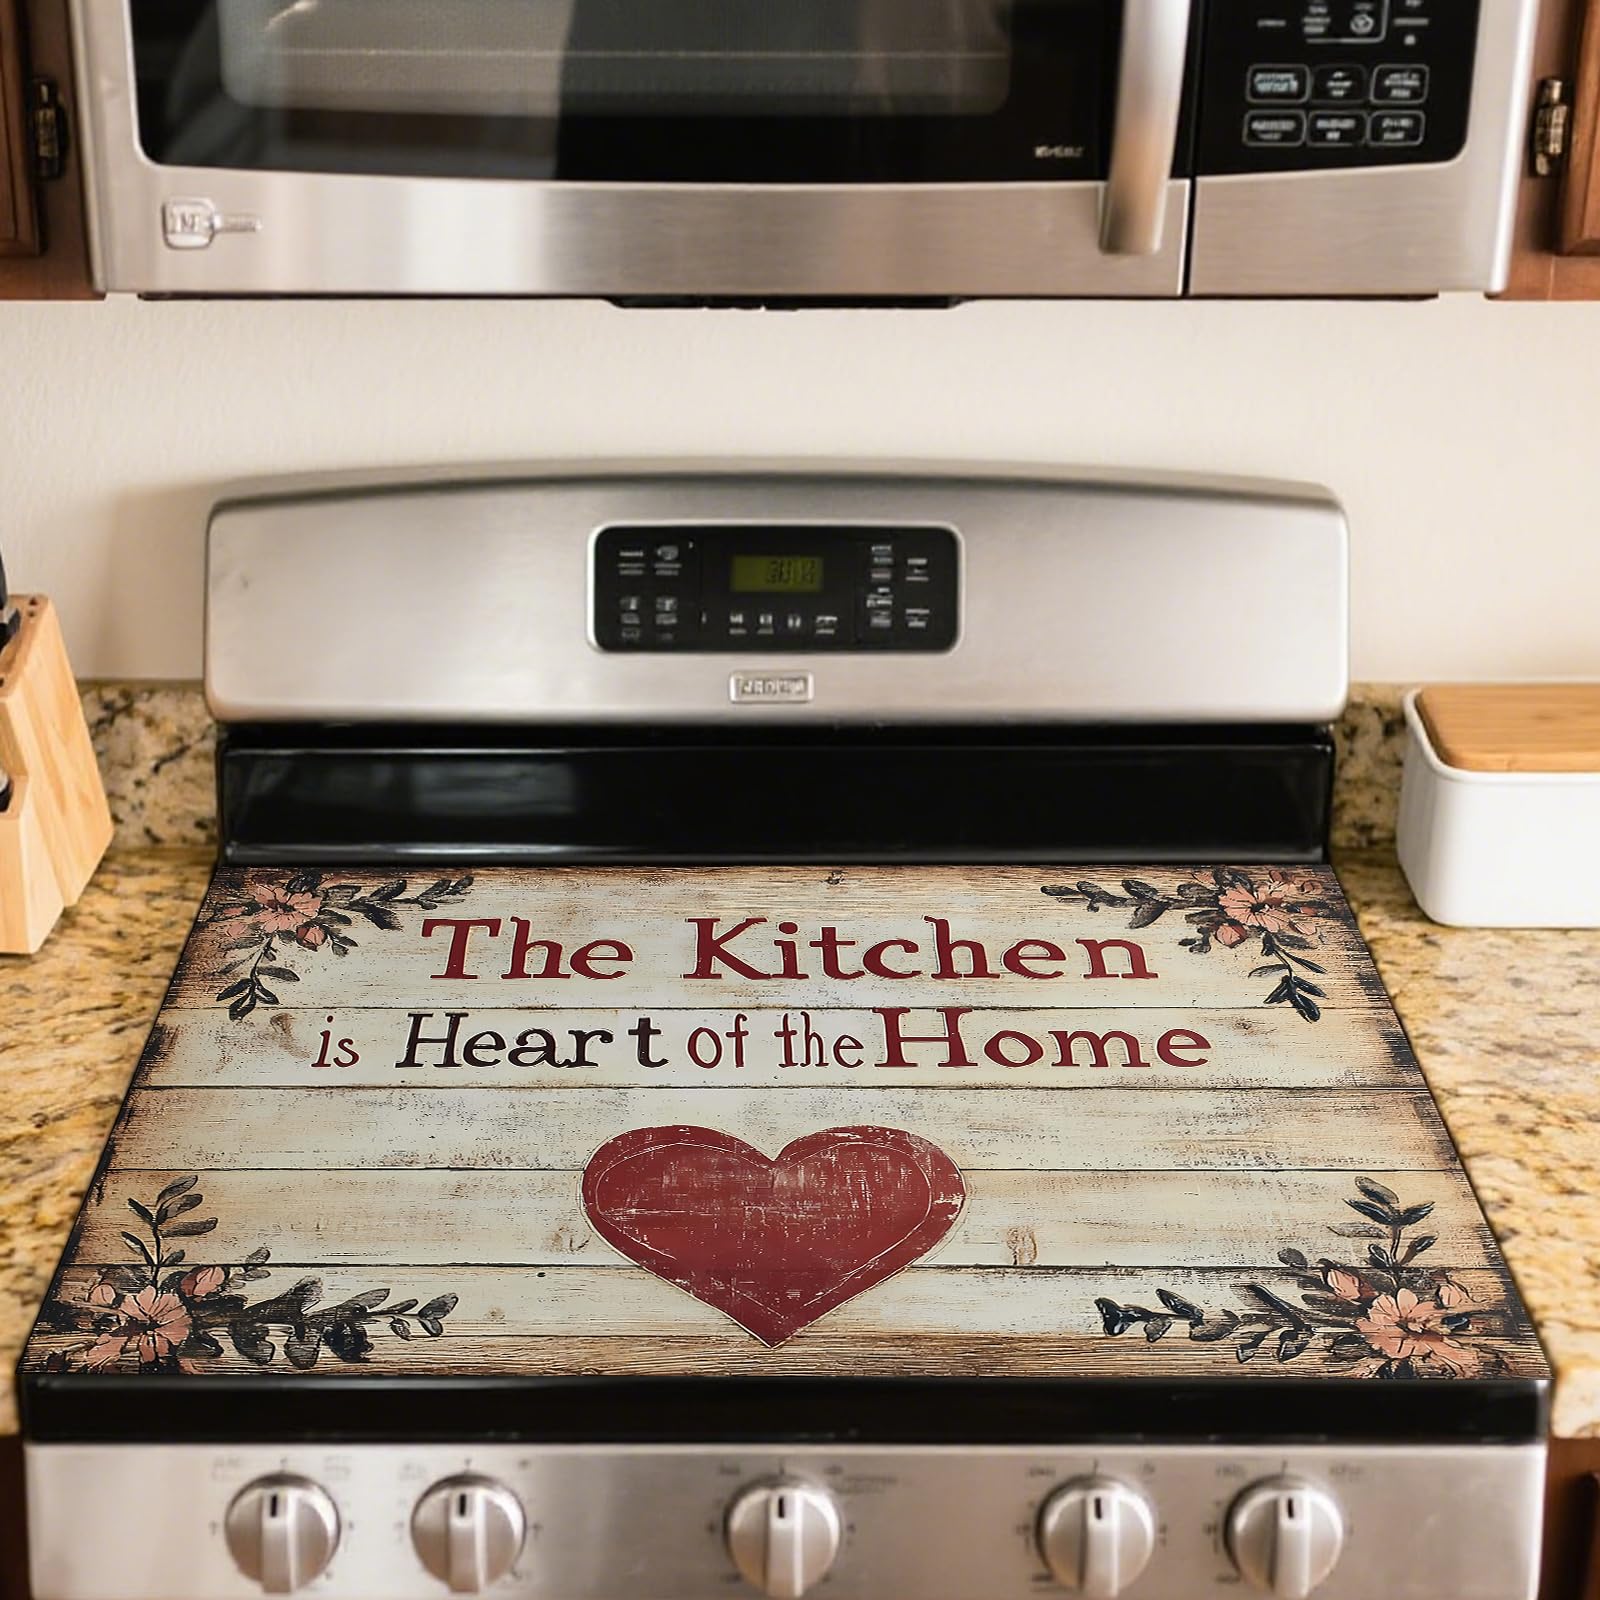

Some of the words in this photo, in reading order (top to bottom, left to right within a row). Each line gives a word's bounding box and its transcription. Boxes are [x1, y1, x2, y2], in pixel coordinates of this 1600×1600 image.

[422, 917, 634, 980] The
[683, 916, 1159, 981] Kitchen
[311, 1014, 360, 1068] is
[395, 1012, 669, 1069] Heart
[688, 1013, 749, 1068] of
[773, 1010, 865, 1069] the
[874, 1007, 1212, 1068] Home
